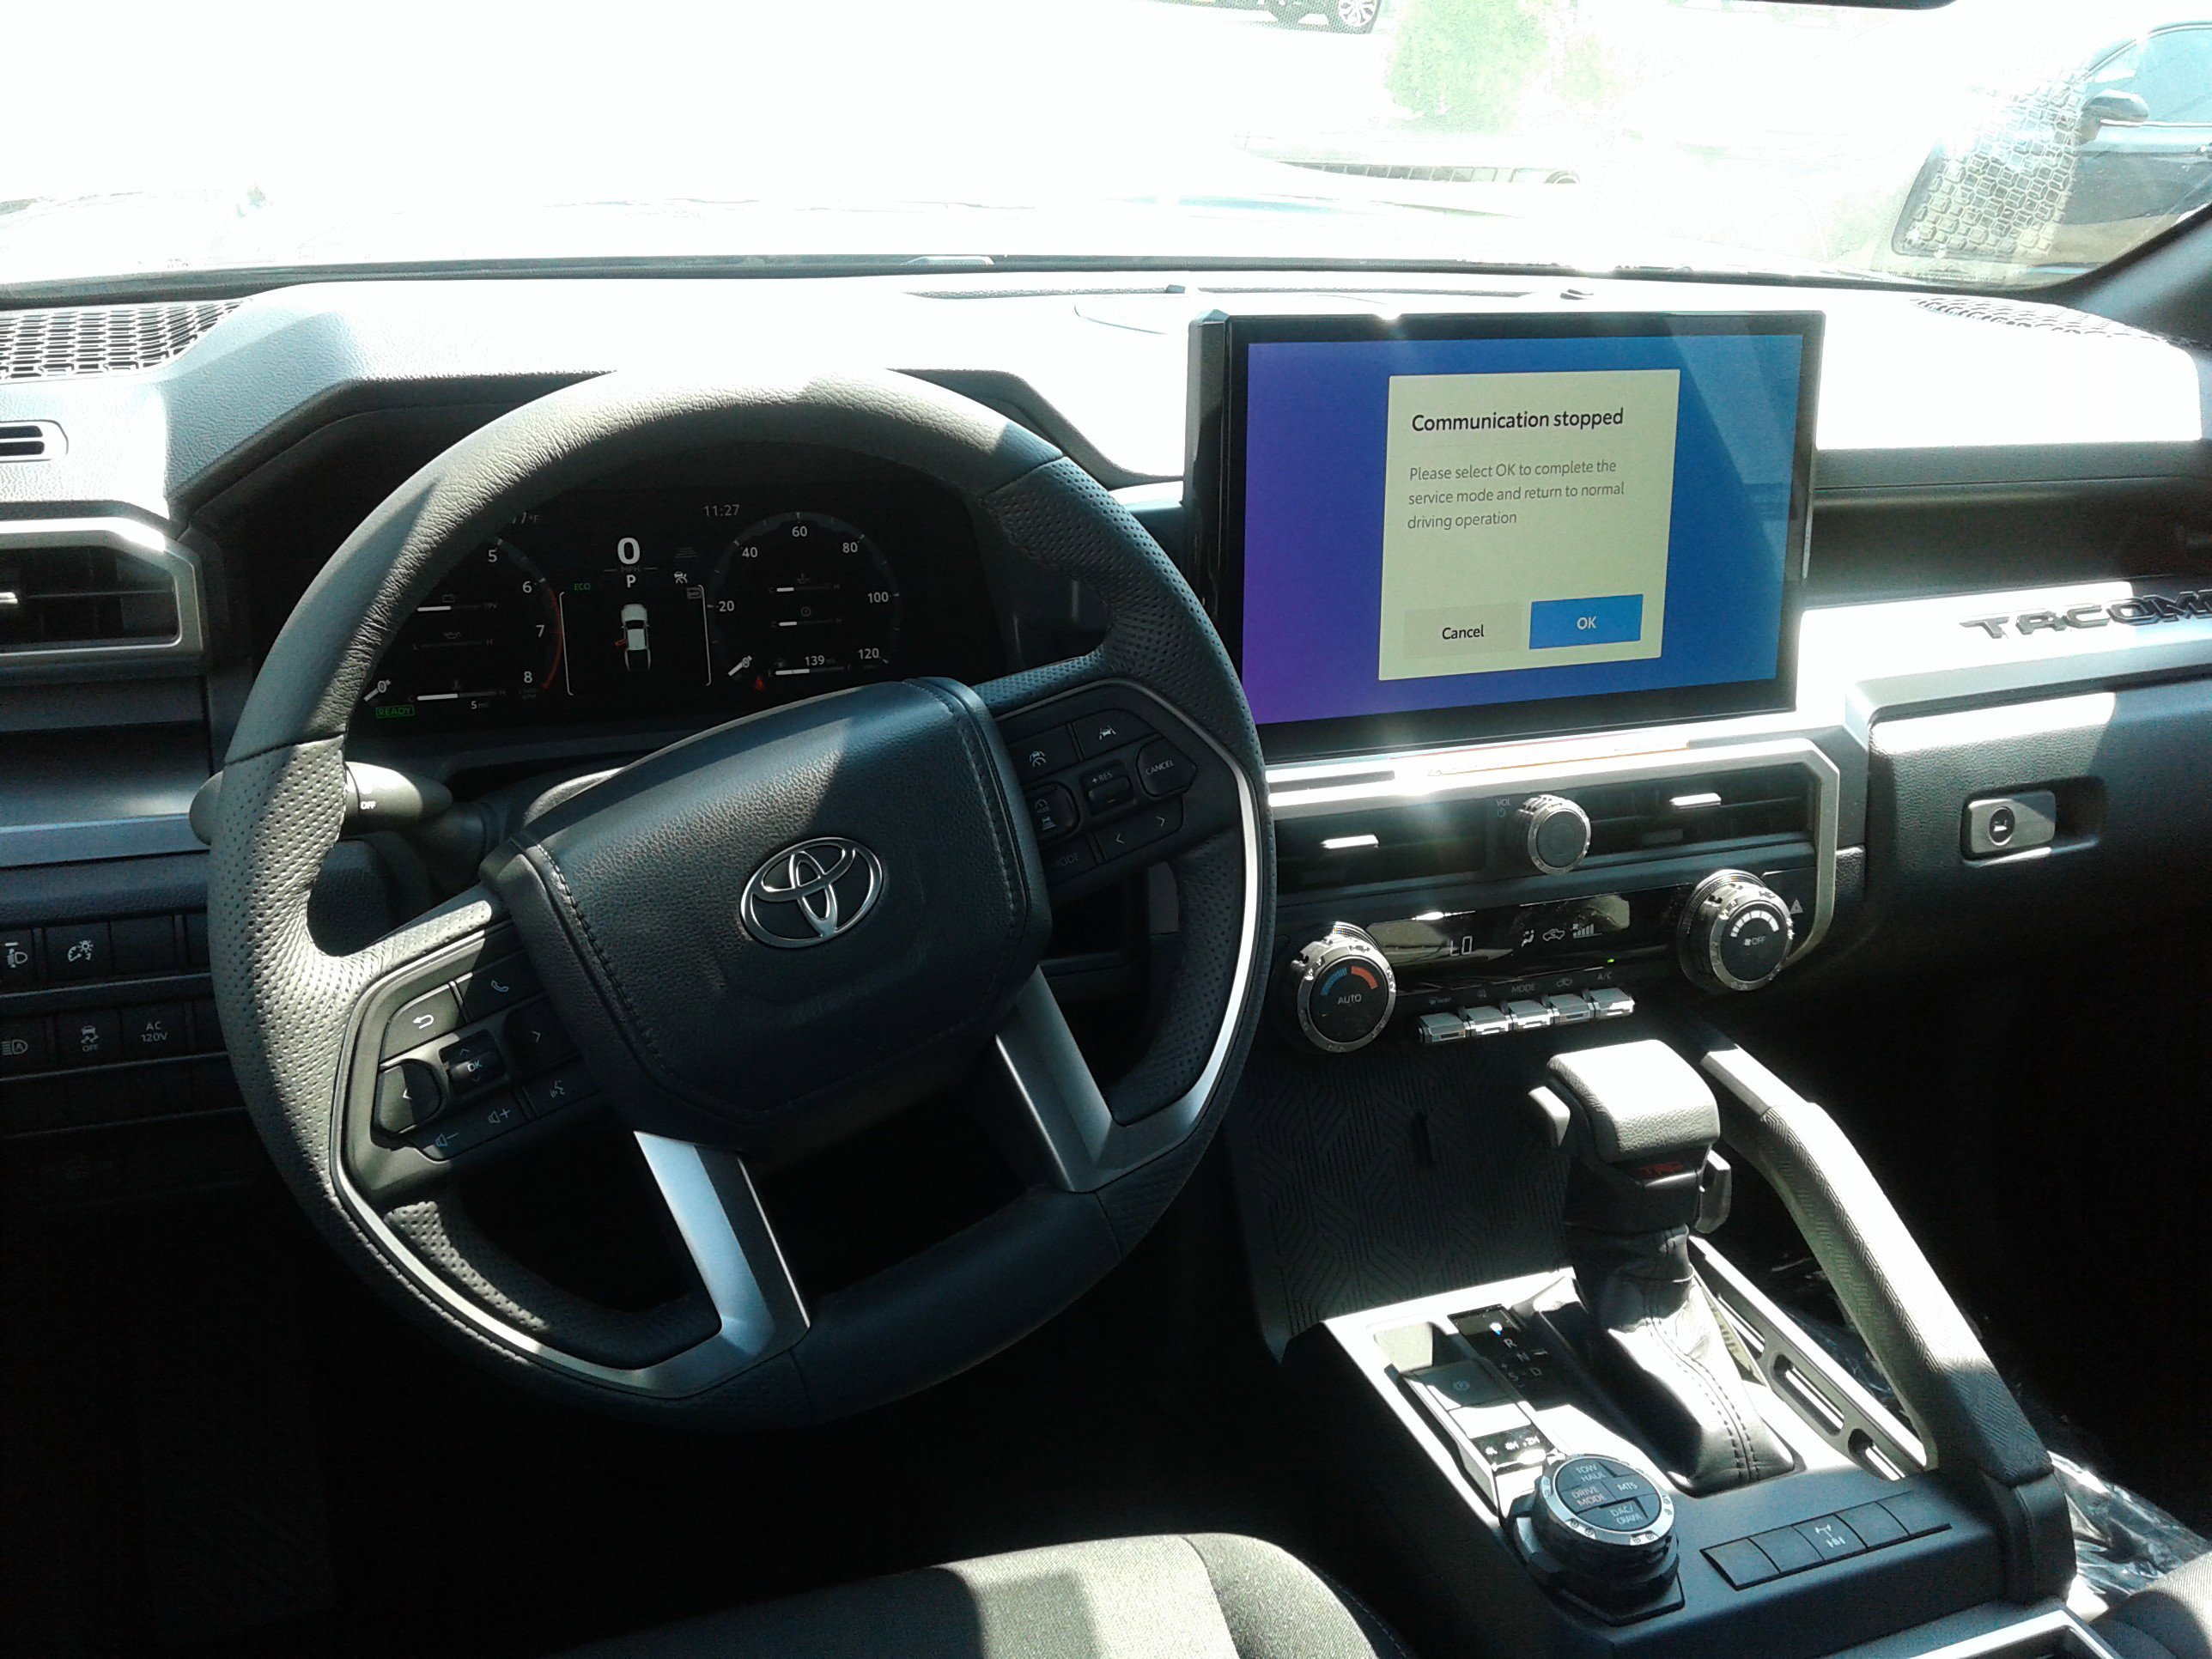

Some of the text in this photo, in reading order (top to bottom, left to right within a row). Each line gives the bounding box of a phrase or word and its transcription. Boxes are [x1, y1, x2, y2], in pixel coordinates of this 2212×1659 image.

[1411, 407, 1624, 432] Communication stopped
[1409, 459, 1617, 481] Please select OK to complete the
[1408, 482, 1625, 506] service mode and return to normal
[703, 504, 740, 517] 11:27
[1407, 512, 1517, 531] driving operation
[792, 526, 808, 538] 60
[617, 537, 641, 565] 0
[741, 546, 759, 559] 40
[842, 542, 858, 554] 80
[487, 549, 498, 563] 5
[522, 580, 532, 593] 6
[626, 574, 636, 588] P
[867, 592, 890, 604] 100
[718, 600, 735, 613] 20
[1576, 616, 1596, 630] OK
[536, 623, 545, 638] 7
[1441, 624, 1485, 640] Cancel
[858, 648, 880, 660] 120
[804, 655, 826, 667] 139
[523, 671, 534, 684] 8
[377, 705, 413, 718] READY
[471, 701, 477, 710] 5
[1146, 759, 1174, 775] CANCEL
[360, 800, 376, 810] OFF
[1449, 935, 1474, 956] LO
[1751, 936, 1765, 945] OFF
[1596, 971, 1613, 981] A/C
[1511, 982, 1535, 994] MODE
[1337, 994, 1362, 1005] AUTO
[145, 1021, 162, 1030] AC
[141, 1032, 168, 1043] 120V
[467, 1060, 483, 1073] OK
[1503, 1338, 1517, 1349] R
[1571, 1486, 1600, 1498] DRIVE
[1616, 1481, 1638, 1492] MTS
[1577, 1492, 1607, 1506] MODE
